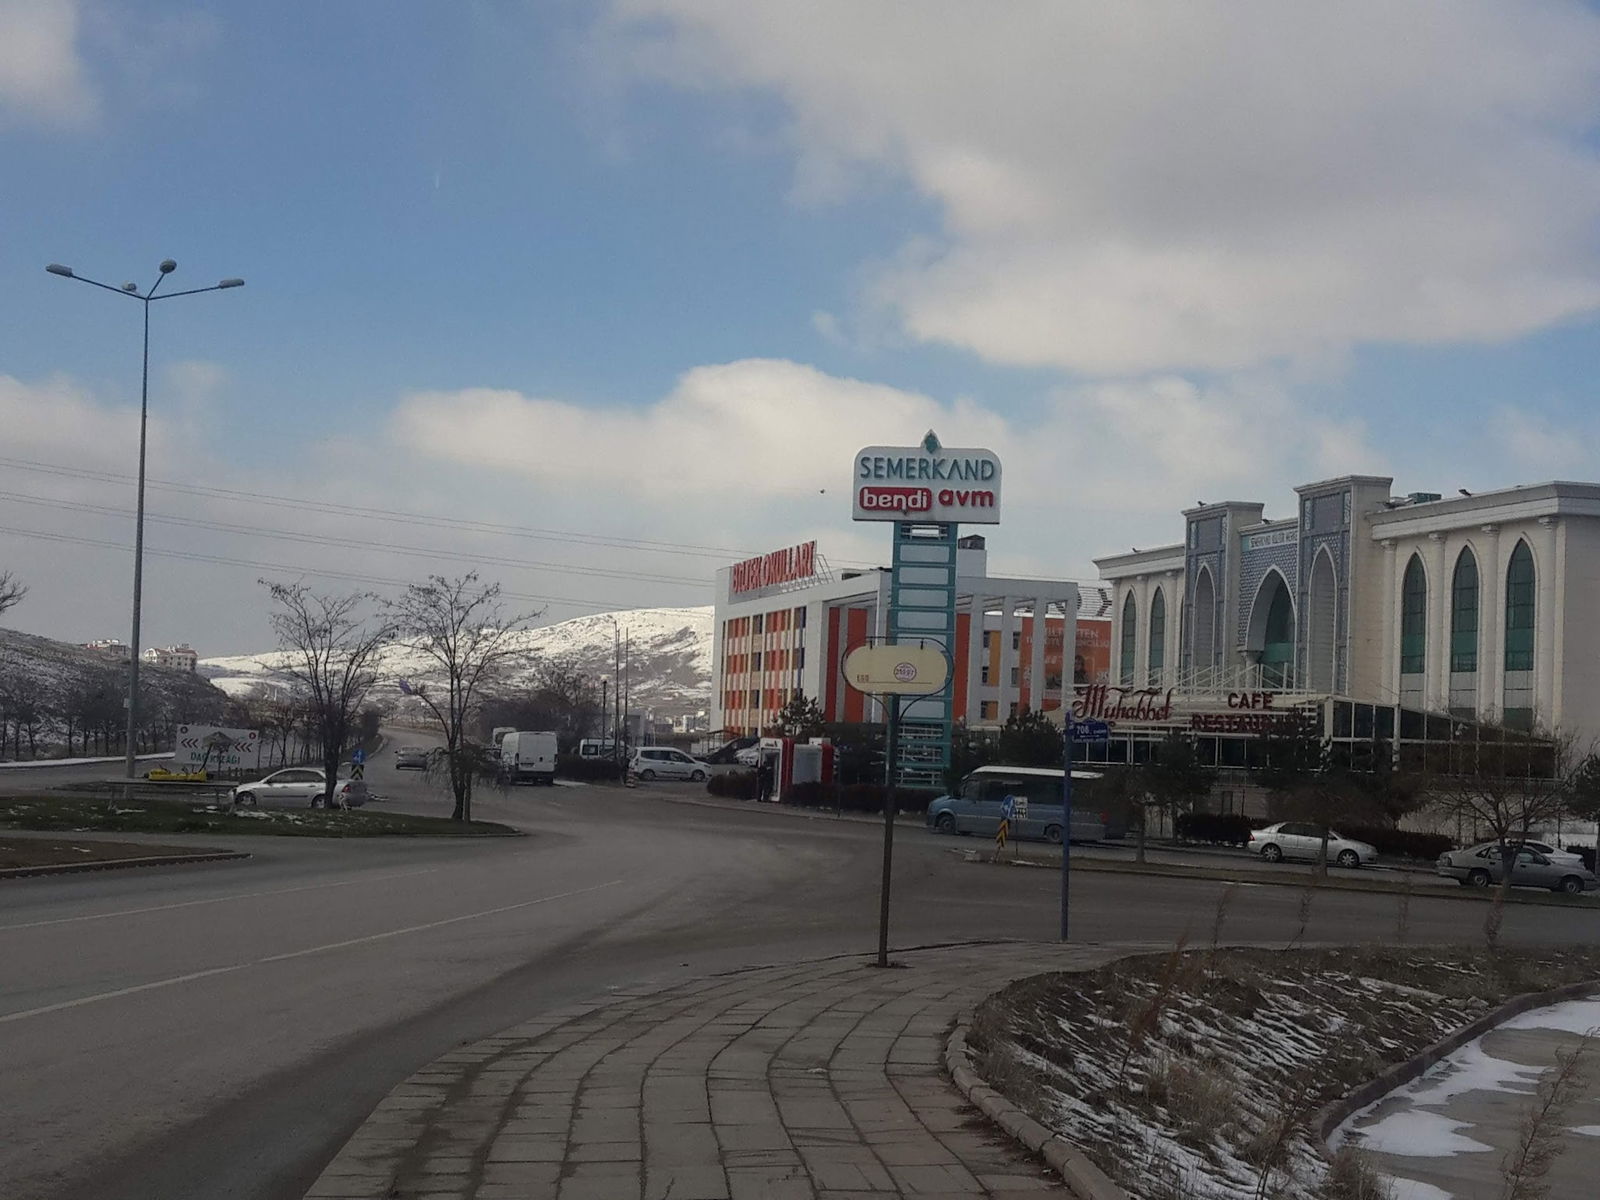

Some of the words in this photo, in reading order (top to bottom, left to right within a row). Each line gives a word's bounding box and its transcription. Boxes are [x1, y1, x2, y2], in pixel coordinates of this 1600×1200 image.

[860, 456, 995, 481] SEMERKAND
[862, 487, 928, 511] bendi
[938, 488, 994, 508] avm
[1072, 683, 1176, 721] Muhabbet
[1228, 692, 1273, 711] CAFE
